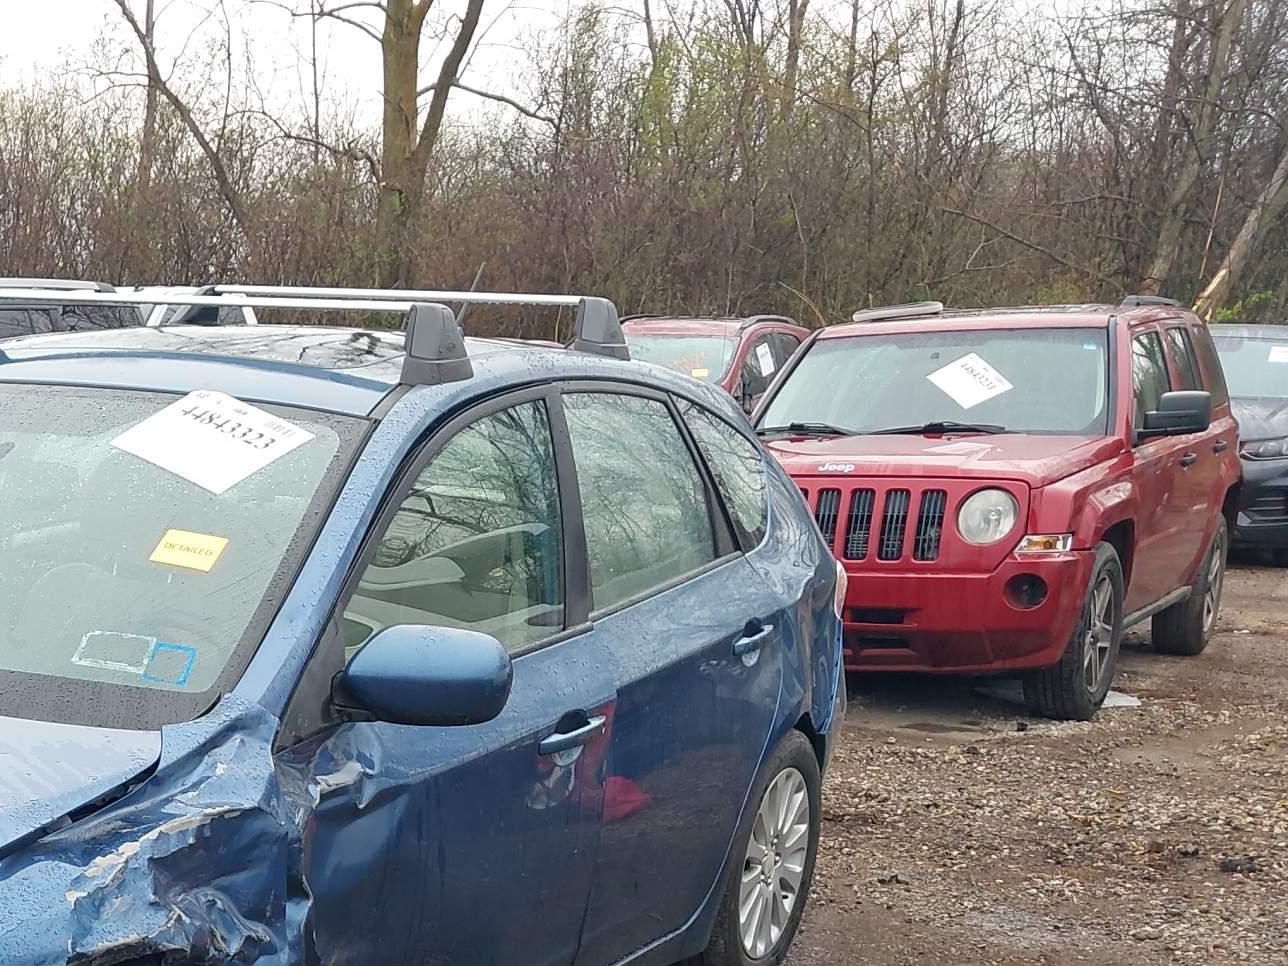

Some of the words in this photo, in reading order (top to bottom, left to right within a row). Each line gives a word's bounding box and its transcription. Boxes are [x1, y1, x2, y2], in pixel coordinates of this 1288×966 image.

[181, 406, 276, 449] 44843323
[817, 463, 856, 473] Jeep
[163, 542, 213, 557] DETAILED
